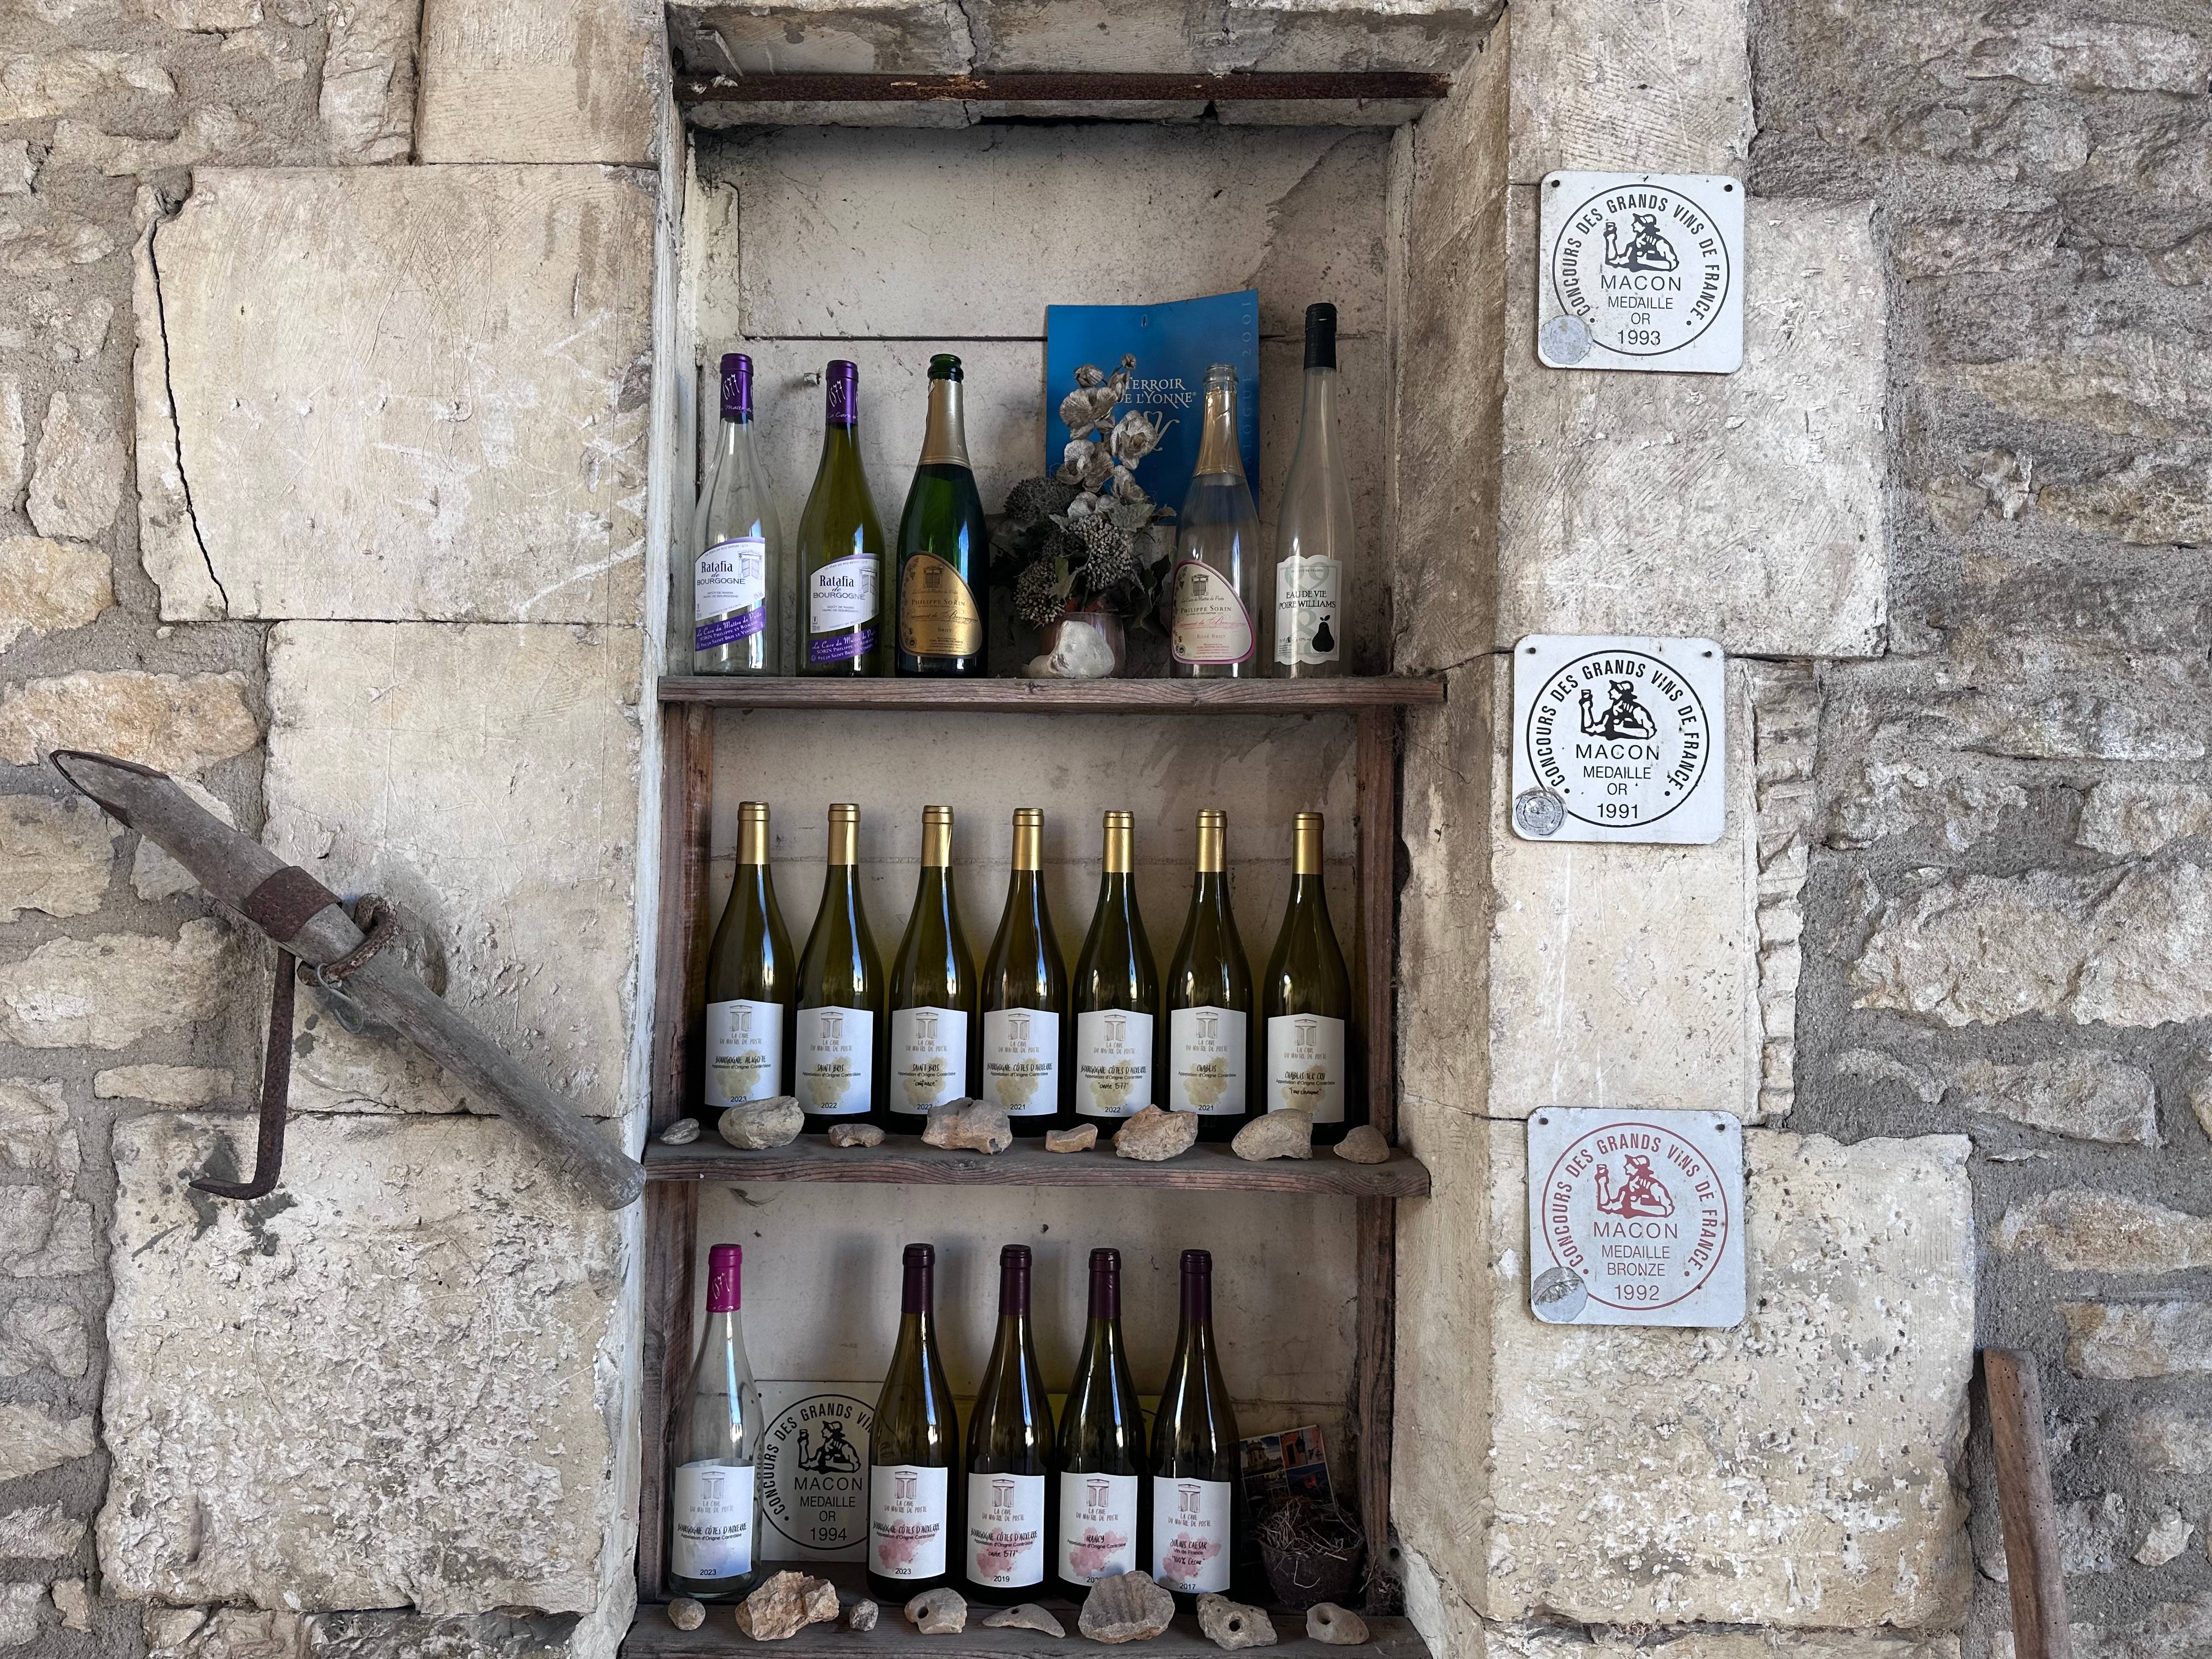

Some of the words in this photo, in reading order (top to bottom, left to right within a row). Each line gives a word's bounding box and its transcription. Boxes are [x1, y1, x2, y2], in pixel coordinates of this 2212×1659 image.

[1606, 194, 1668, 213] GRANDS
[1575, 208, 1603, 235] DES
[1672, 205, 1705, 235] VINS
[1699, 238, 1717, 258] DE
[1562, 237, 1591, 317] CONCOURS
[1601, 275, 1681, 291] MACON
[1690, 264, 1720, 321] FRANCE
[1608, 296, 1673, 309] MEDAILLE
[1630, 313, 1650, 325] OR
[1242, 302, 1251, 356] 2001
[1617, 330, 1661, 346] 1993
[1124, 393, 1132, 403] E
[1243, 373, 1252, 476] ALOGUE
[701, 561, 733, 573] Ratafia
[820, 575, 854, 587] Ratafia
[813, 592, 865, 600] BOURGOGNE
[1582, 659, 1646, 680] GRANDS
[1550, 675, 1579, 703] DES
[1651, 670, 1684, 702] VINS
[1677, 705, 1697, 726] DE
[1536, 706, 1566, 788] CONCOURS
[1576, 744, 1659, 760] MACON
[1668, 732, 1699, 791] FRANCE
[1583, 766, 1651, 780] MEDAILLE
[1607, 783, 1628, 795] OR
[1597, 803, 1638, 819] 1991
[715, 1056, 742, 1064] BOURGOGNE
[987, 1062, 1010, 1071] BOURGOGNE
[1013, 1062, 1029, 1071] CÔTES
[817, 1064, 831, 1072] SAINT
[832, 1064, 844, 1073] BRIS
[913, 1064, 927, 1072] SAINT
[928, 1064, 940, 1073] BRIS
[1080, 1064, 1106, 1074] BOURGOGNE
[1108, 1065, 1124, 1074] CÔTES
[1197, 1064, 1217, 1073] CHABLIS
[1285, 1071, 1305, 1080] CHABLIS
[1596, 1133, 1661, 1154] GRANDS
[1565, 1149, 1594, 1178] DES
[1667, 1144, 1700, 1177] VINS
[1694, 1181, 1714, 1202] DE
[1552, 1181, 1584, 1267] CONCOURS
[1594, 1222, 1678, 1239] MACON
[1688, 1209, 1717, 1271] FRANCE
[1602, 1245, 1670, 1259] MEDAILLE
[1607, 1262, 1665, 1276] BRONZE
[1614, 1284, 1659, 1301] 1992
[800, 1403, 853, 1421] GRANDS
[774, 1417, 797, 1441] DES
[856, 1412, 871, 1433] VI
[763, 1443, 786, 1515] CONCOURS
[794, 1477, 862, 1491] MACON
[800, 1496, 855, 1508] MEDAILLE
[819, 1511, 836, 1522] OR
[678, 1523, 702, 1535] BOURGOGNE
[810, 1527, 848, 1541] 1994
[873, 1521, 896, 1533] BOURGOGNE
[899, 1524, 915, 1534] CÔTES
[970, 1527, 995, 1541] BOURGOGNE
[997, 1531, 1013, 1542] CÔTES
[1086, 1534, 1104, 1543] IRANCY
[1170, 1538, 1187, 1549] JULIUS
[1188, 1541, 1207, 1550] CAESAR
